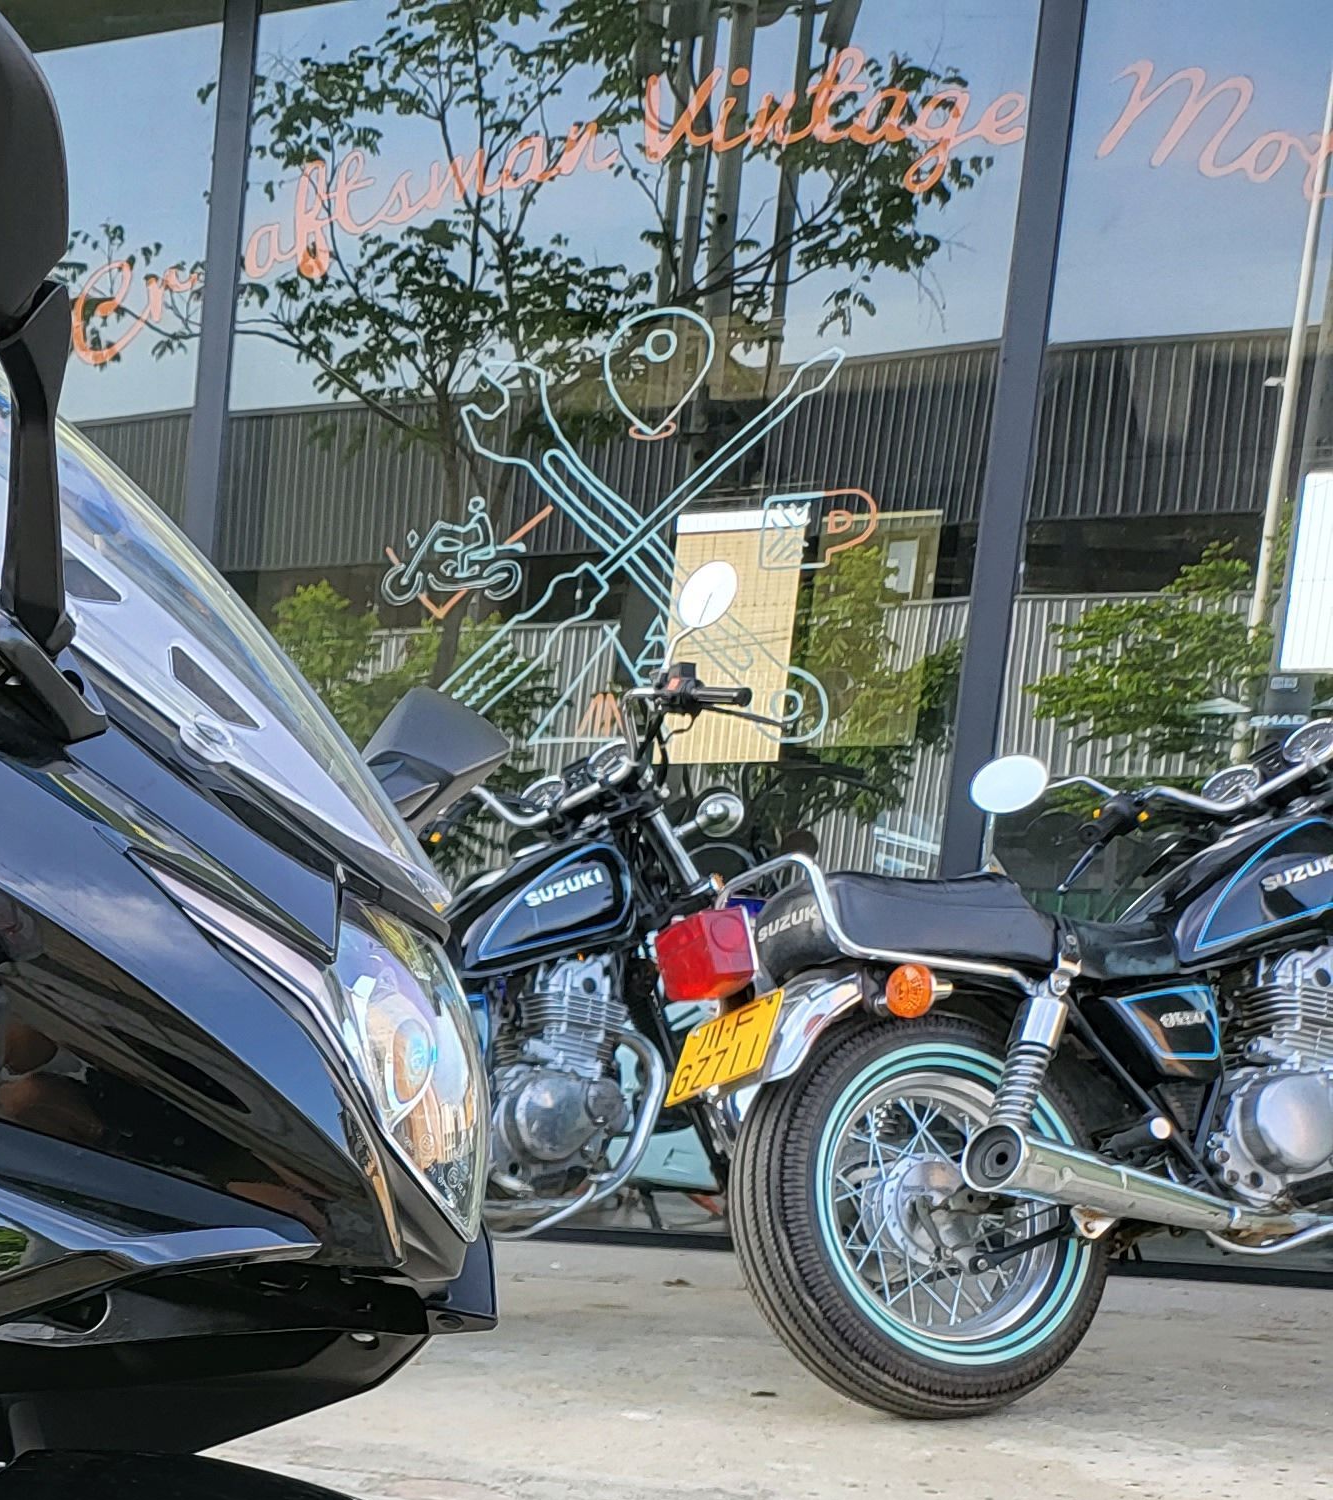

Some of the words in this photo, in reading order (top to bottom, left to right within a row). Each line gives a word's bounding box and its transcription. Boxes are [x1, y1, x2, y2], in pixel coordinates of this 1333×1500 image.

[644, 45, 1027, 193] Vintage
[523, 867, 605, 907] SUZUKI
[757, 904, 822, 943] SUZUK
